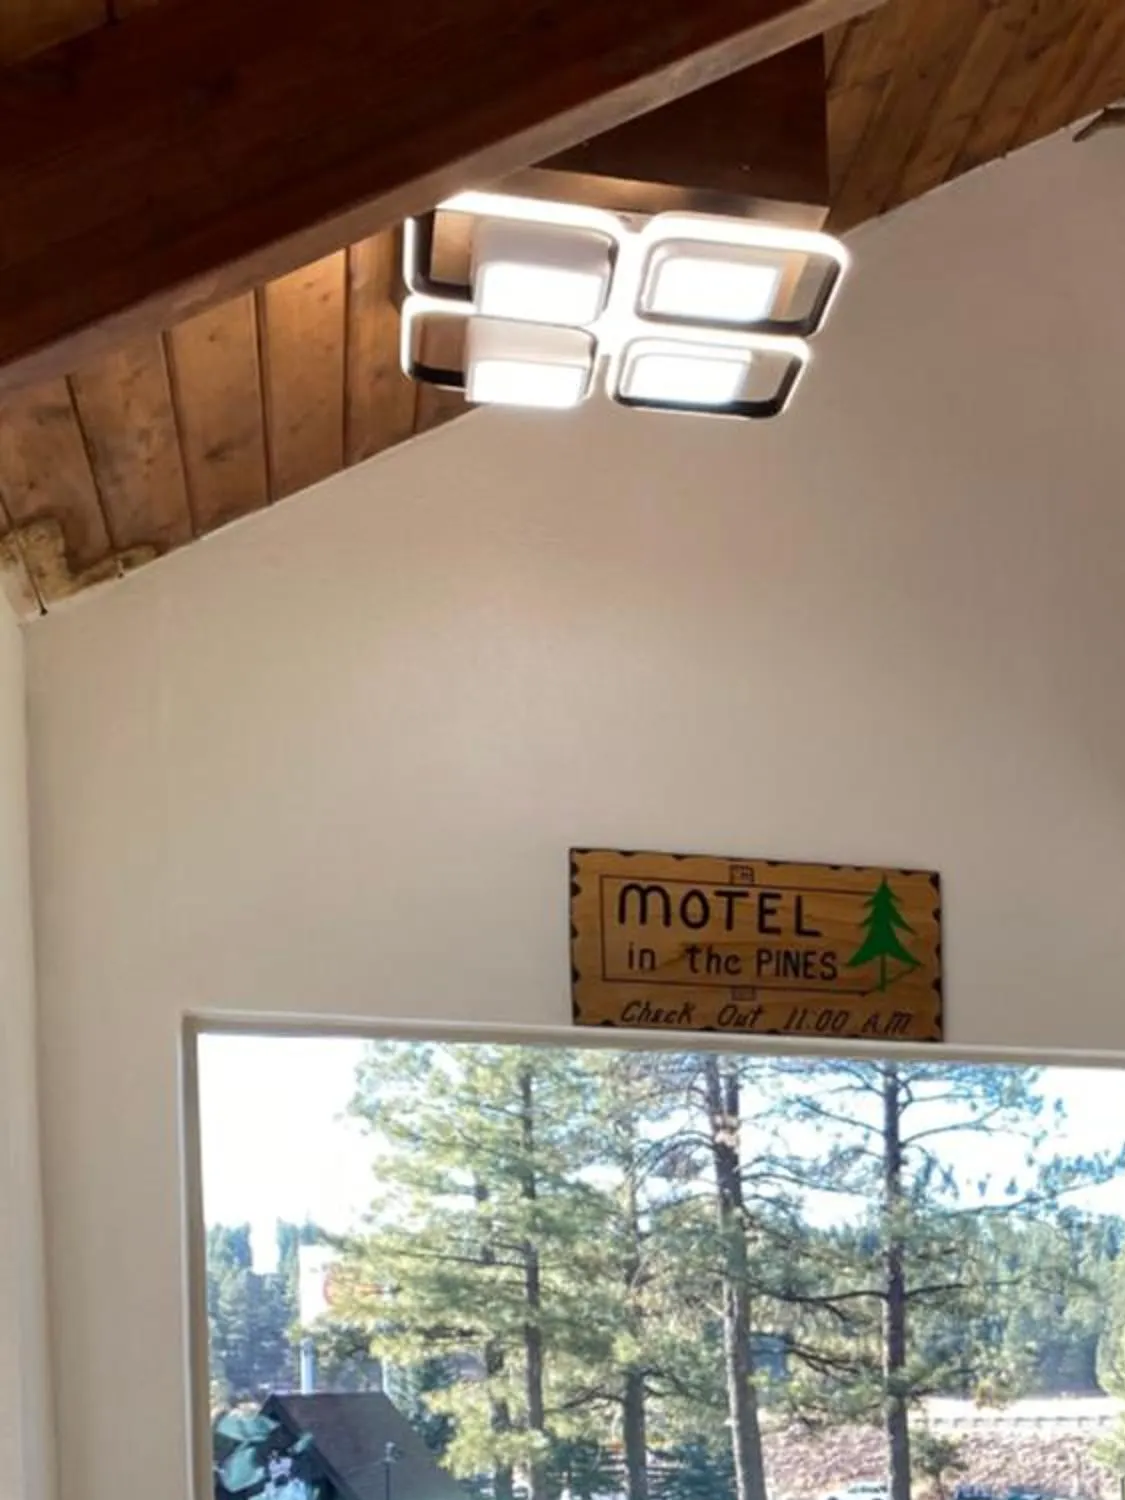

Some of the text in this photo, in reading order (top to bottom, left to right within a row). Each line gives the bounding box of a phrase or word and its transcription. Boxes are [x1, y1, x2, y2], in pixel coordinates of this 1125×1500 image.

[618, 883, 822, 937] MOTEL
[628, 942, 838, 980] in the PINES
[621, 1000, 695, 1024] Check
[717, 1003, 763, 1027] Out
